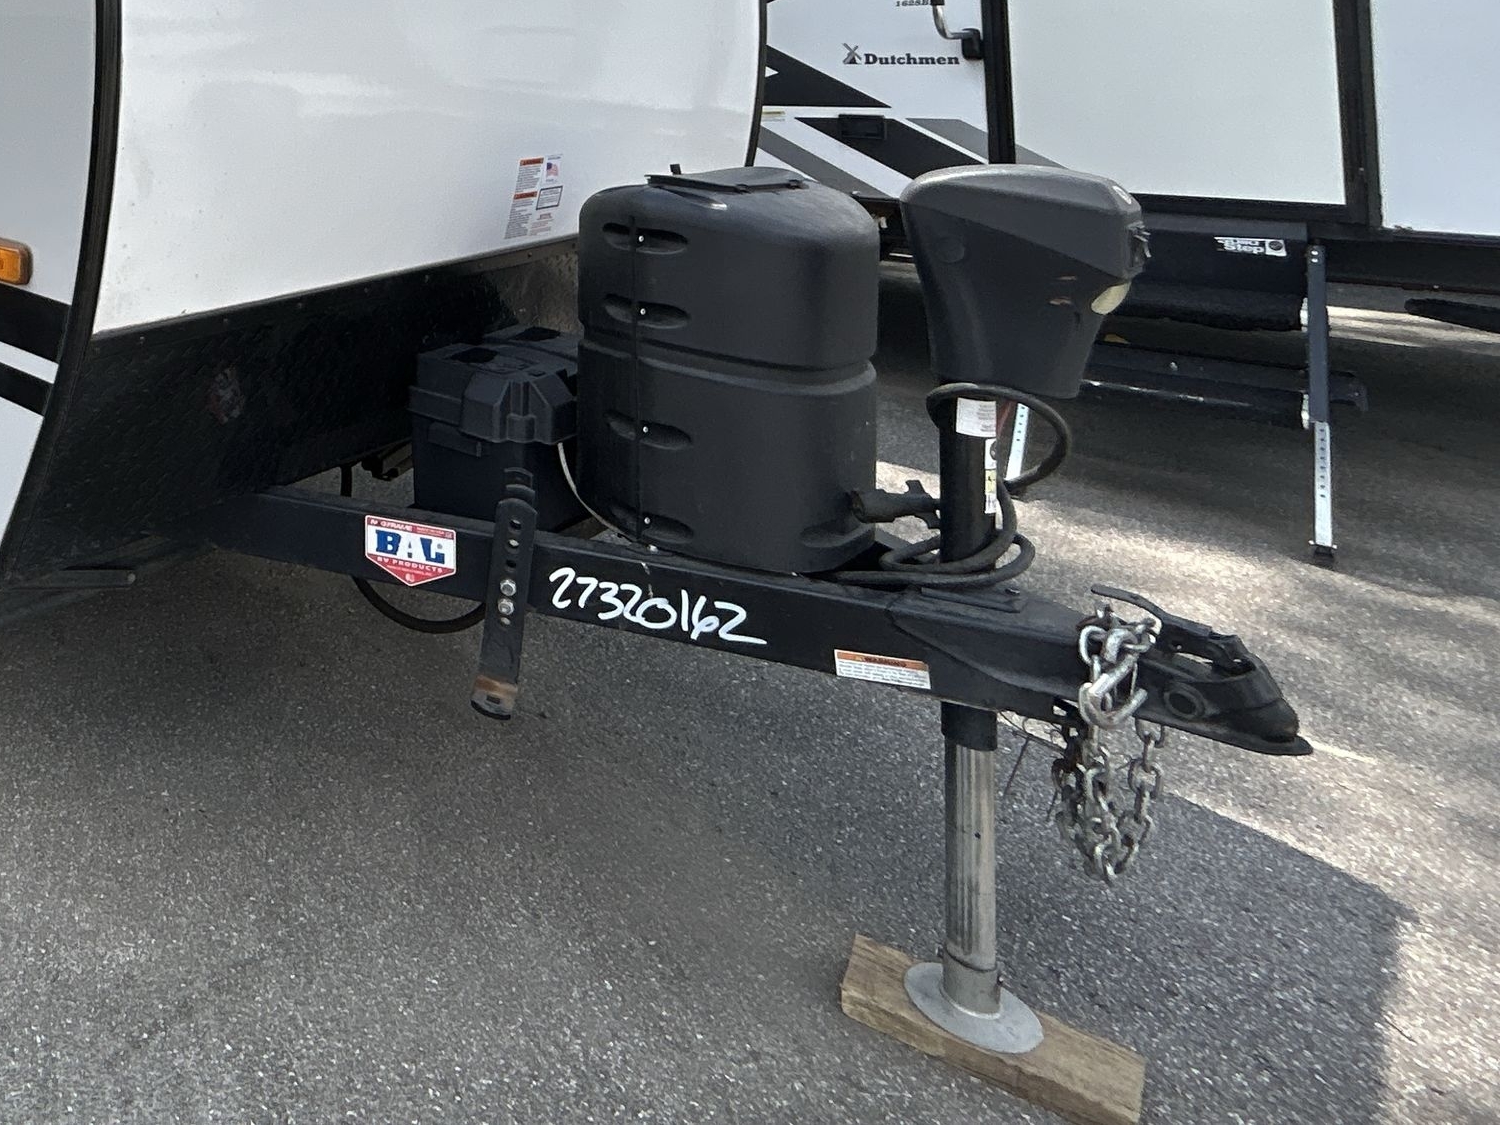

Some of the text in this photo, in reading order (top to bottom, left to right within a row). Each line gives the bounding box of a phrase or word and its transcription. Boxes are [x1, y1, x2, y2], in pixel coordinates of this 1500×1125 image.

[864, 53, 960, 65] Dutchmen
[375, 529, 445, 565] BAL
[392, 559, 443, 574] PRODUCTS
[549, 567, 768, 645] 27320162
